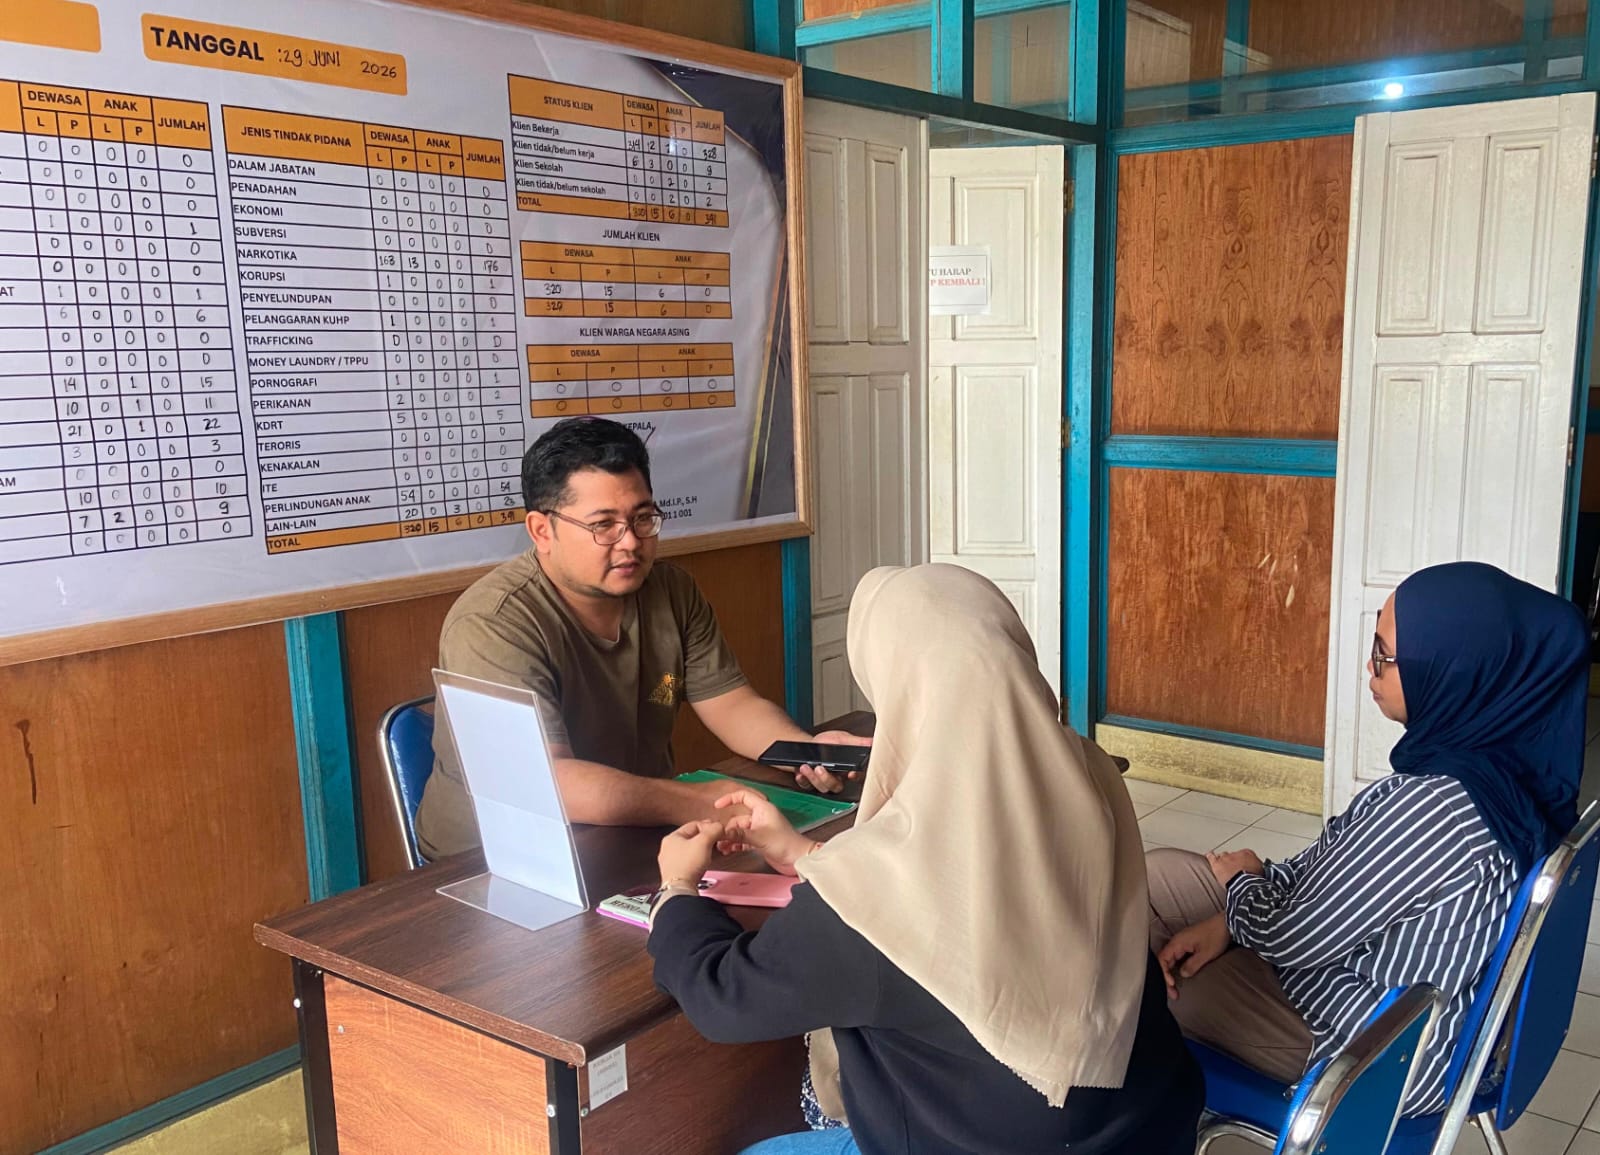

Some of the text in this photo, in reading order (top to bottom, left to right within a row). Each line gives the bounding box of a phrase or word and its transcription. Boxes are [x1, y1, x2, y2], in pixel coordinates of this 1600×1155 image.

[150, 26, 264, 61] TANGGAL
[309, 50, 340, 67] JUNI
[361, 61, 397, 79] 2026
[27, 90, 206, 132] DEWASA ANAK JUMLAH
[544, 97, 593, 112] STATUS KLIEN
[627, 101, 720, 131] DEWASA ANAK JUMLAH
[37, 117, 143, 136] L P L P
[512, 121, 559, 136] Klien Bekerja
[631, 119, 635, 127] L
[241, 126, 351, 147] JENIS TINDAK PIDANA
[370, 131, 500, 165] DEWASA ANAK JUMLAH
[514, 140, 594, 159] Klien tidak/belum kerja
[229, 159, 315, 176] DALAM JABATAN
[377, 154, 455, 169] L P L P
[516, 159, 563, 173] Klien Sekolah
[649, 159, 654, 169] 3
[231, 182, 296, 196] PENADAHAN
[517, 178, 606, 195] Klien tidak/belum sekolah
[518, 196, 541, 207] TOTAL
[234, 205, 283, 217] EKONOMI
[235, 227, 286, 238] SUBVERSI
[602, 230, 660, 241] JUMLAH KLIEN
[238, 249, 297, 261] NARKOTIKA
[565, 249, 692, 263] DEWASA ANAK
[379, 255, 395, 267] 163
[408, 256, 419, 269] 13
[240, 271, 286, 282] KORUPSI
[938, 278, 979, 286] KEMBALI
[544, 284, 711, 298] 320 15 6 0
[243, 293, 332, 304] PENYELUNDUPAN
[605, 303, 614, 313] 15
[245, 314, 349, 325] PELANGGARAN KUHP
[580, 328, 689, 337] KLIEN WARGA NEGARA ASING
[247, 336, 313, 346] TRAFFICKING
[571, 349, 600, 357] DEWASA
[249, 357, 287, 367] MONEY
[289, 357, 336, 366] LAUNDRY
[343, 356, 368, 365] TPPU
[63, 376, 213, 392] 14 0 1 0 15
[251, 378, 317, 388] PORNOGRAFI
[66, 397, 212, 416] 10 1 11
[253, 398, 311, 409] PERIKANAN
[67, 419, 221, 436] 21 0 1 0 22
[256, 421, 283, 431] KDRT
[258, 440, 301, 451] TERORIS
[260, 460, 320, 472] KENAKALAN
[80, 482, 226, 503] 10 10
[262, 483, 278, 493] ITE
[401, 489, 416, 502] 54
[265, 495, 371, 513] PERLINDUNGAN ANAK
[79, 502, 229, 528] 7 2 9
[405, 508, 418, 518] 20
[453, 504, 460, 513] 3
[266, 519, 316, 532] LAIN-LAIN
[429, 522, 439, 533] 15
[268, 537, 300, 548] TOTAL
